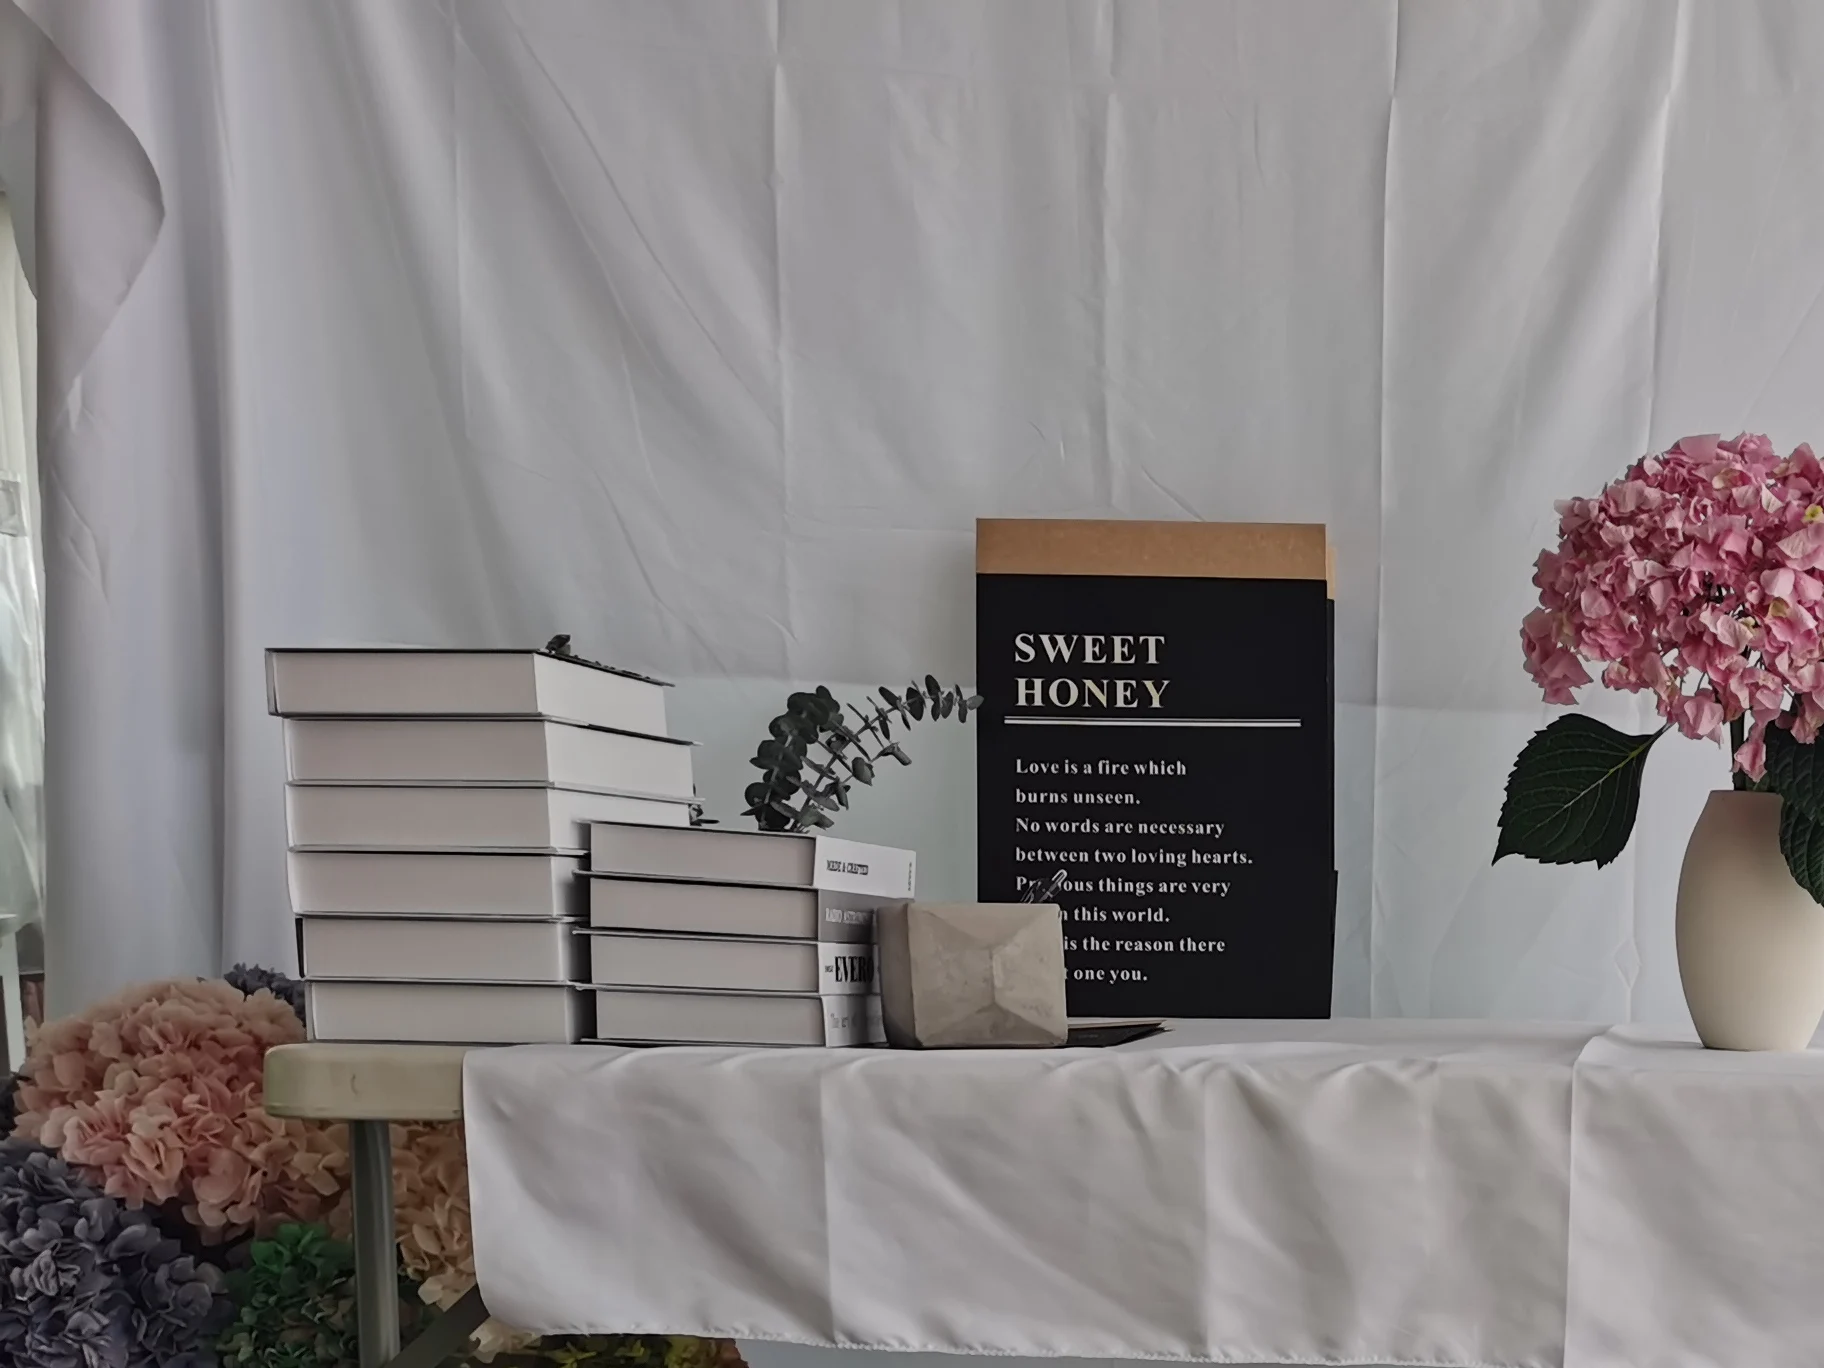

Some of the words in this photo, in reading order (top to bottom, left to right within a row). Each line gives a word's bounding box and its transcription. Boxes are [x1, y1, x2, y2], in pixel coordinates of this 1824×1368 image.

[1014, 632, 1165, 665] SWEET
[1015, 677, 1171, 709] HONEY
[1016, 758, 1060, 774] Love
[1064, 759, 1078, 775] is
[1083, 763, 1093, 775] a
[1097, 759, 1130, 775] fire
[1133, 759, 1187, 776] which
[1015, 788, 1068, 804] burns
[1073, 792, 1141, 805] unseen.
[1015, 817, 1041, 833] No
[1044, 818, 1100, 834] words
[1104, 822, 1134, 834] are
[1138, 823, 1225, 839] necessary
[1015, 846, 1089, 863] between
[1094, 848, 1127, 863] two
[1131, 847, 1187, 868] loving
[1191, 848, 1253, 865] hearts.
[1098, 877, 1154, 897] things
[1158, 881, 1187, 894] are
[1191, 882, 1231, 898] very
[1073, 906, 1107, 922] this
[1111, 907, 1171, 923] world.
[1064, 935, 1078, 951] is
[1082, 936, 1111, 952] the
[1115, 940, 1174, 952] reason
[1179, 936, 1226, 953] there
[1073, 969, 1105, 981] one
[1109, 969, 1148, 985] you.
